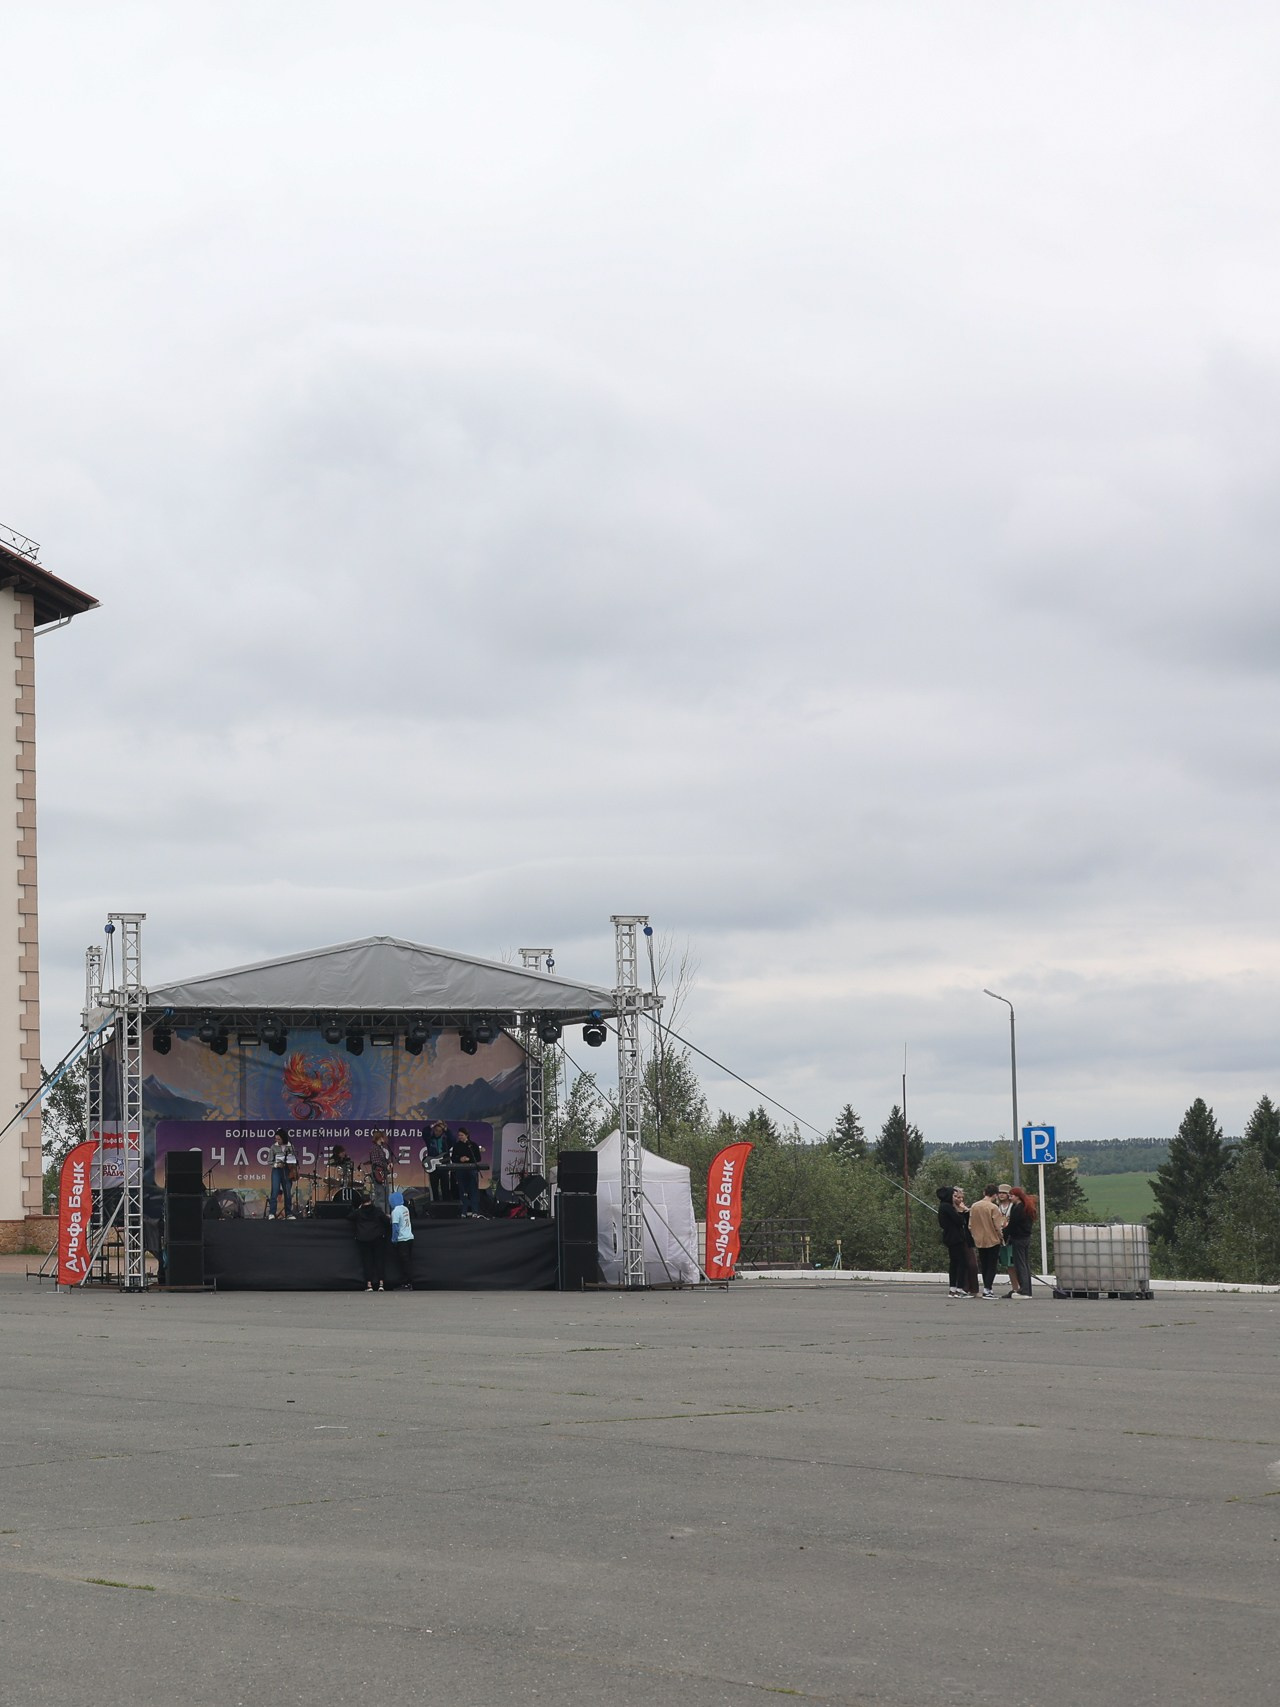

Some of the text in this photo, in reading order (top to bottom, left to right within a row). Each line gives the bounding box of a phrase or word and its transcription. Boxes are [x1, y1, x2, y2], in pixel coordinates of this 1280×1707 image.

[225, 1128, 282, 1138] БОЛЬШО
[287, 1127, 350, 1137] СЕМЕЙНЫЙ
[1031, 1130, 1050, 1160] P
[188, 1146, 334, 1166] ЧАСЬЕ
[65, 1161, 85, 1273] Альфа Банк
[713, 1160, 735, 1267] Альфа Банк
